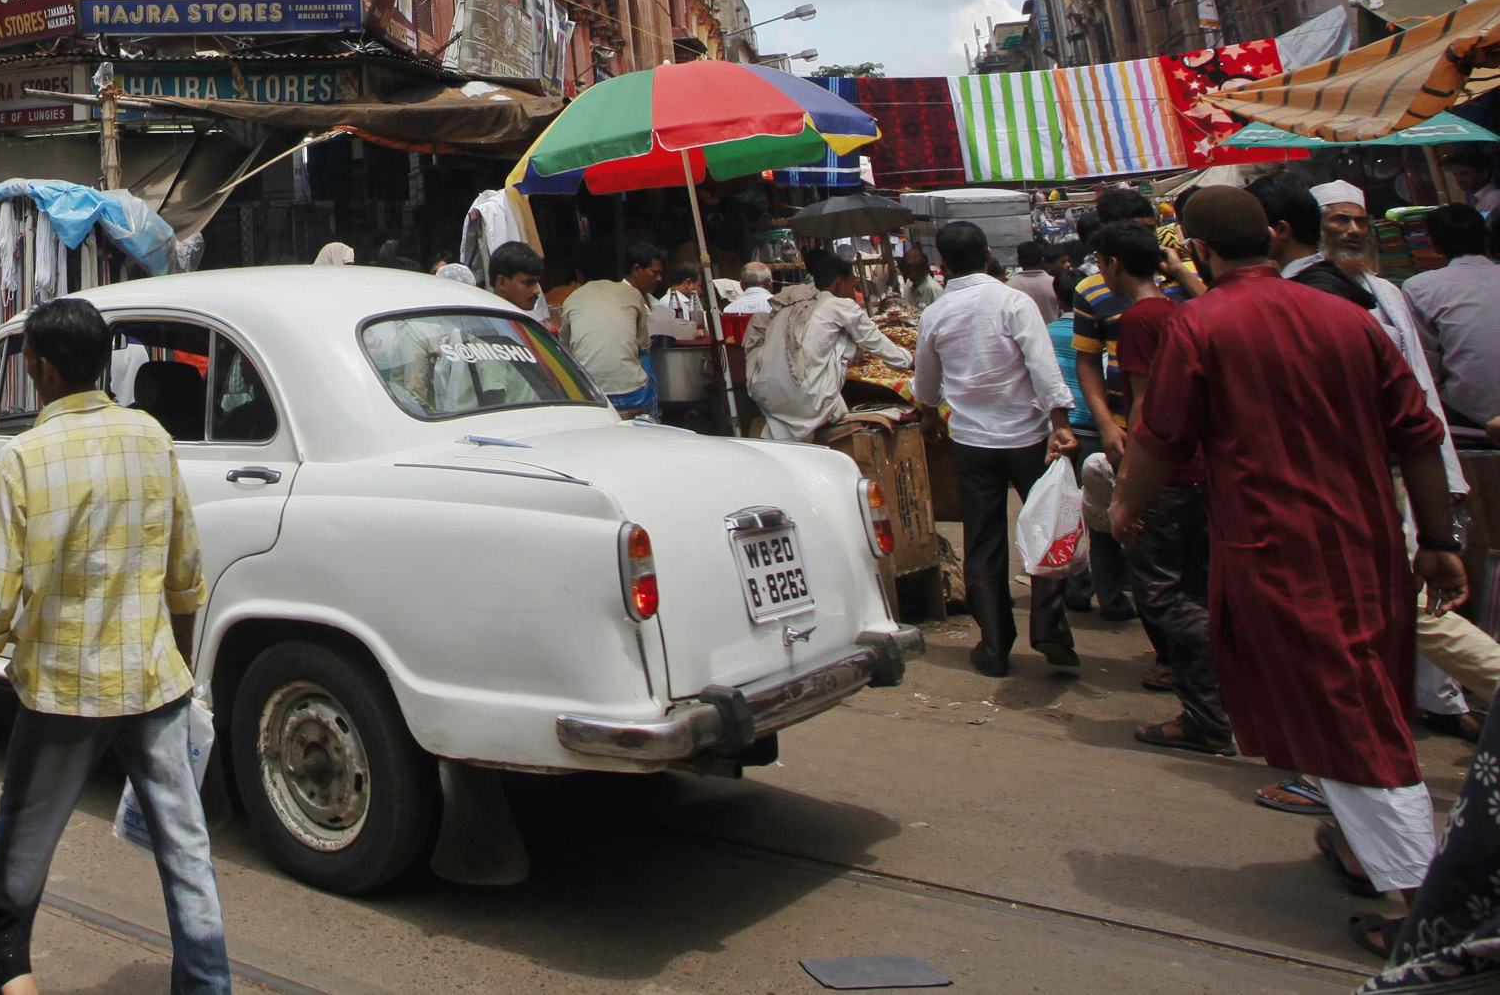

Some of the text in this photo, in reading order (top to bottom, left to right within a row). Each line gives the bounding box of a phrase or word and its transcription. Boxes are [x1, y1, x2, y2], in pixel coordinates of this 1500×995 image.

[4, 10, 46, 37] STORES
[93, 2, 283, 24] HAJRA STORES
[11, 112, 22, 122] OF
[28, 109, 66, 121] LUNGIES
[440, 343, 537, 363] S@MISHU
